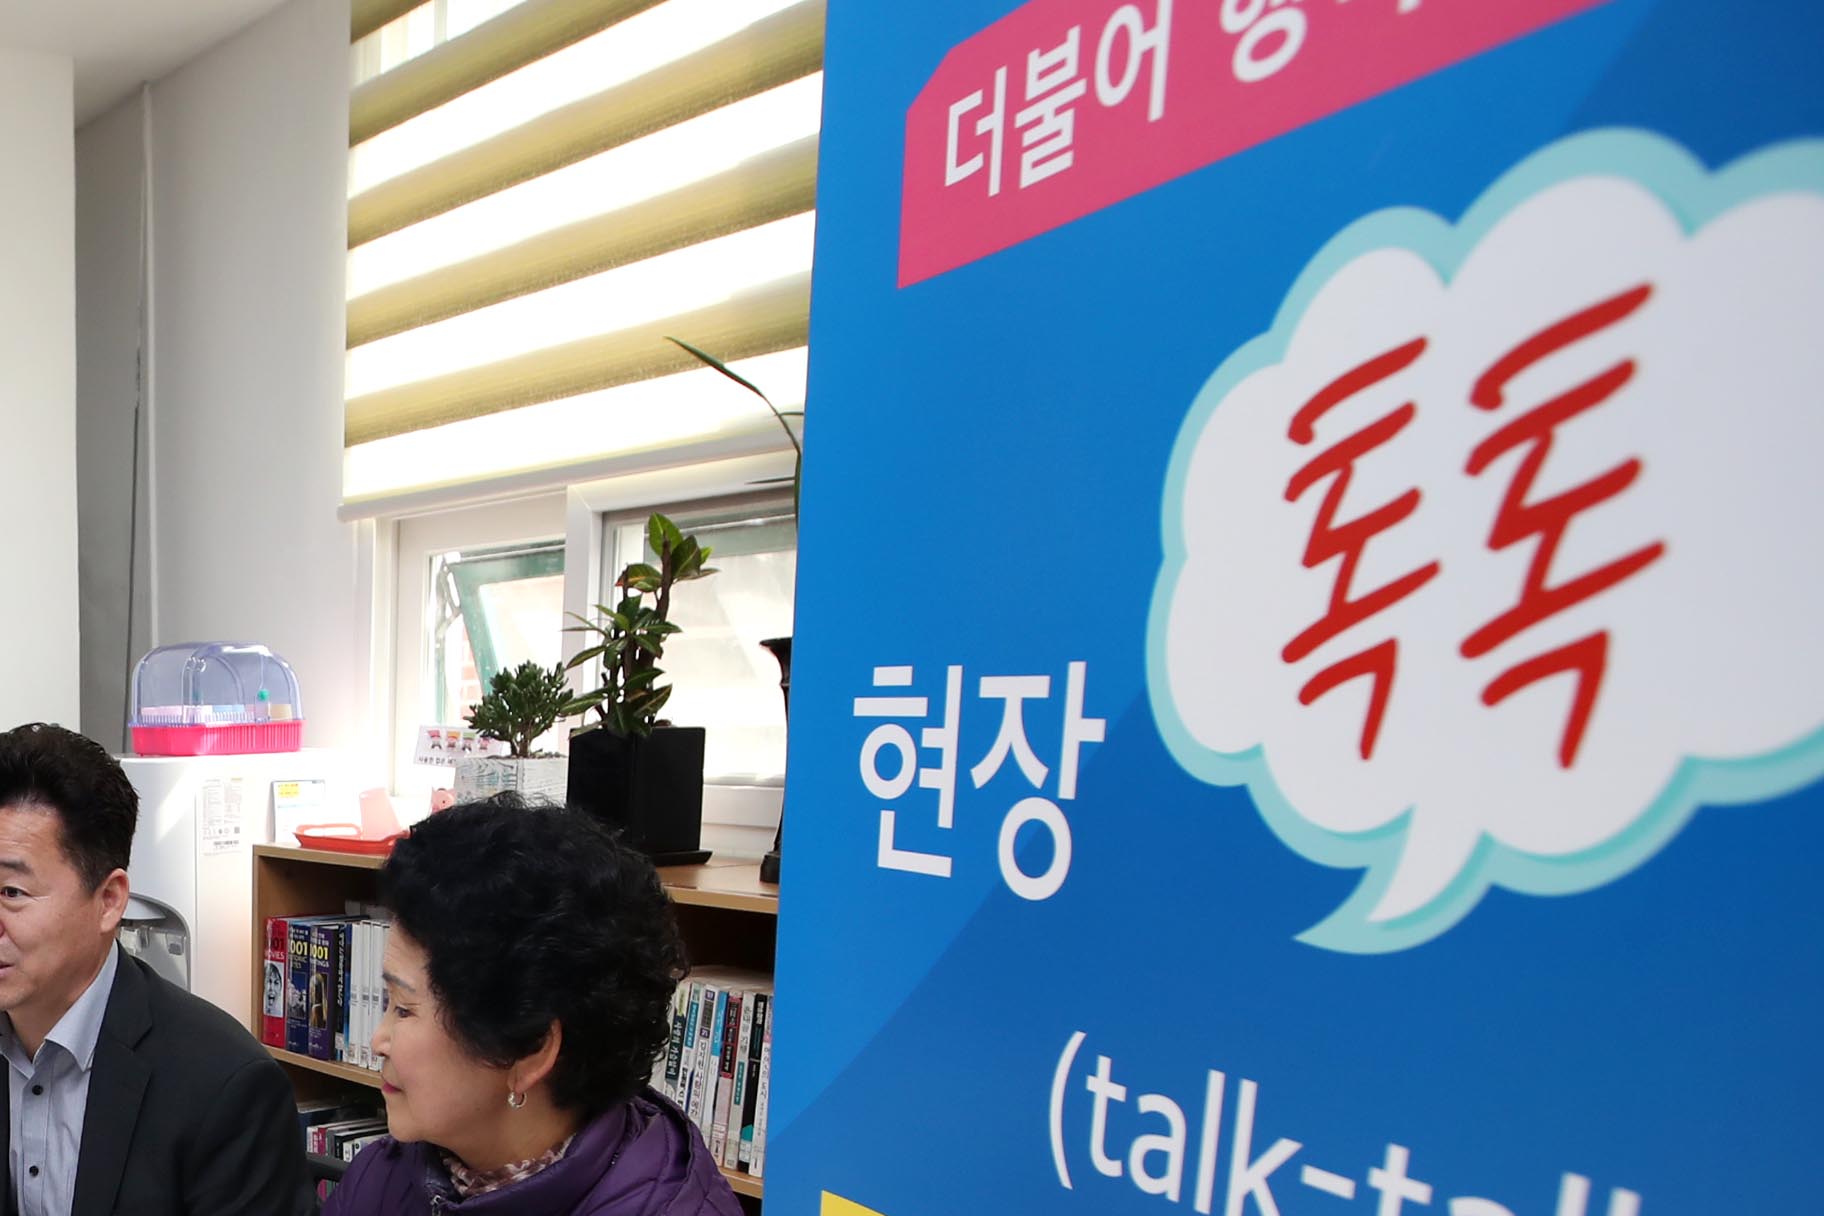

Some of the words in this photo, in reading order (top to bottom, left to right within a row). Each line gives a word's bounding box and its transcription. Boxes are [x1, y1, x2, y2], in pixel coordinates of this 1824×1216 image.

[944, 0, 1171, 198] 더불어
[1280, 282, 1666, 773] 톡톡
[852, 661, 1106, 903] 현장
